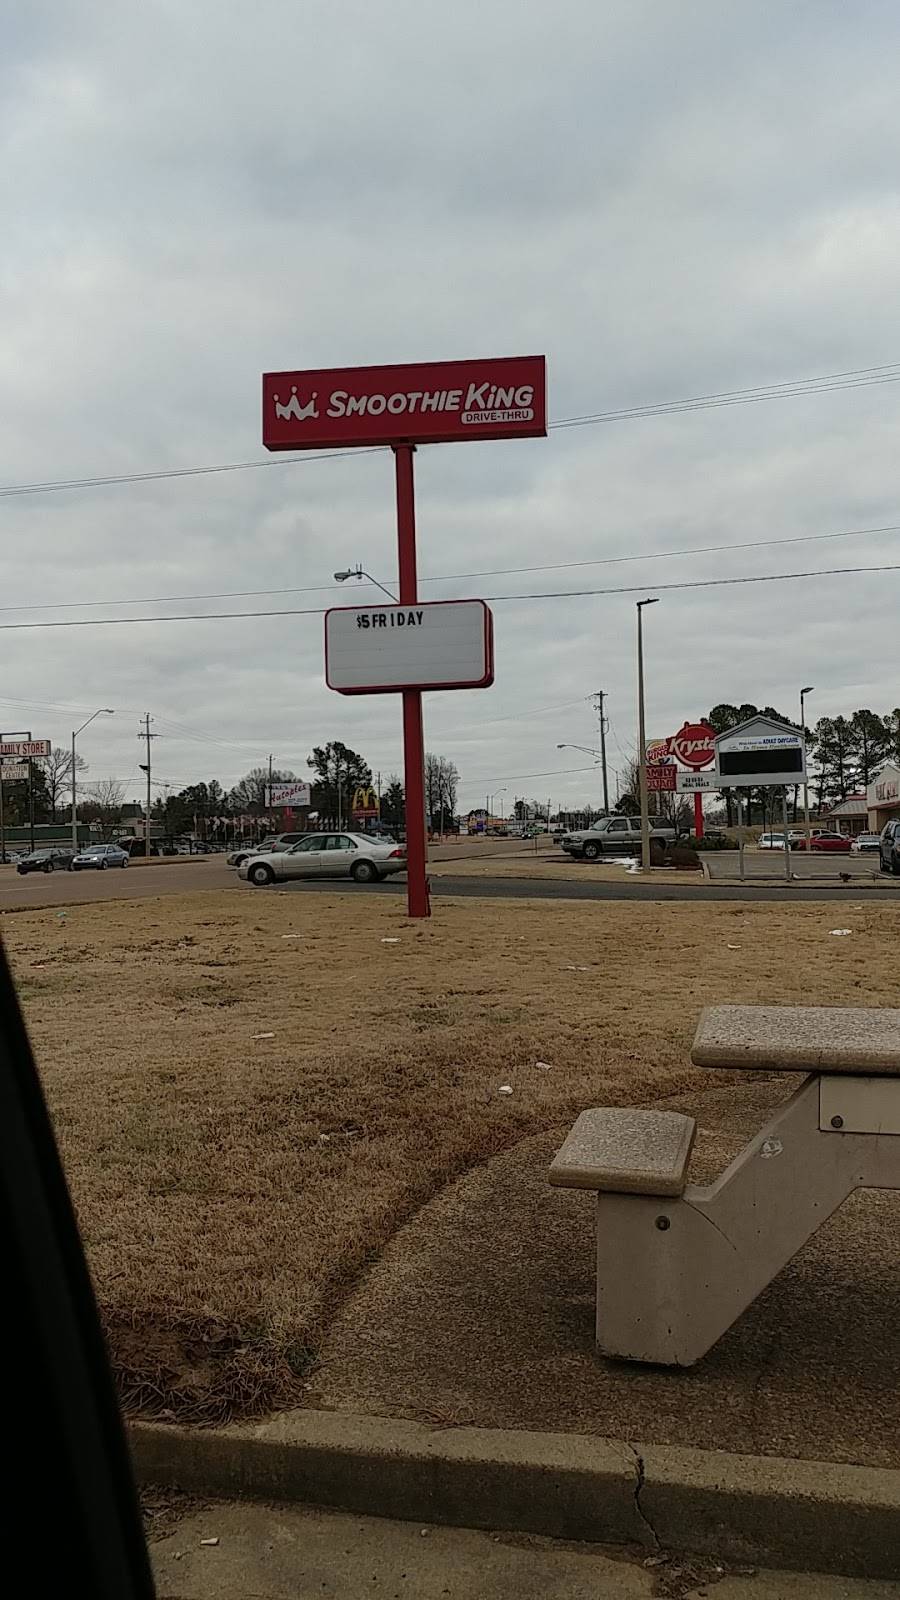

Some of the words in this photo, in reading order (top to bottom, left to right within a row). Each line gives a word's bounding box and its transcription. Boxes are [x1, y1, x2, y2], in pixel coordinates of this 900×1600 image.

[326, 390, 463, 418] SMOOTHIE
[466, 410, 529, 422] DRIVE-THRU
[22, 742, 45, 755] STORE
[669, 736, 716, 756] Krysta
[5, 771, 25, 779] CENTER
